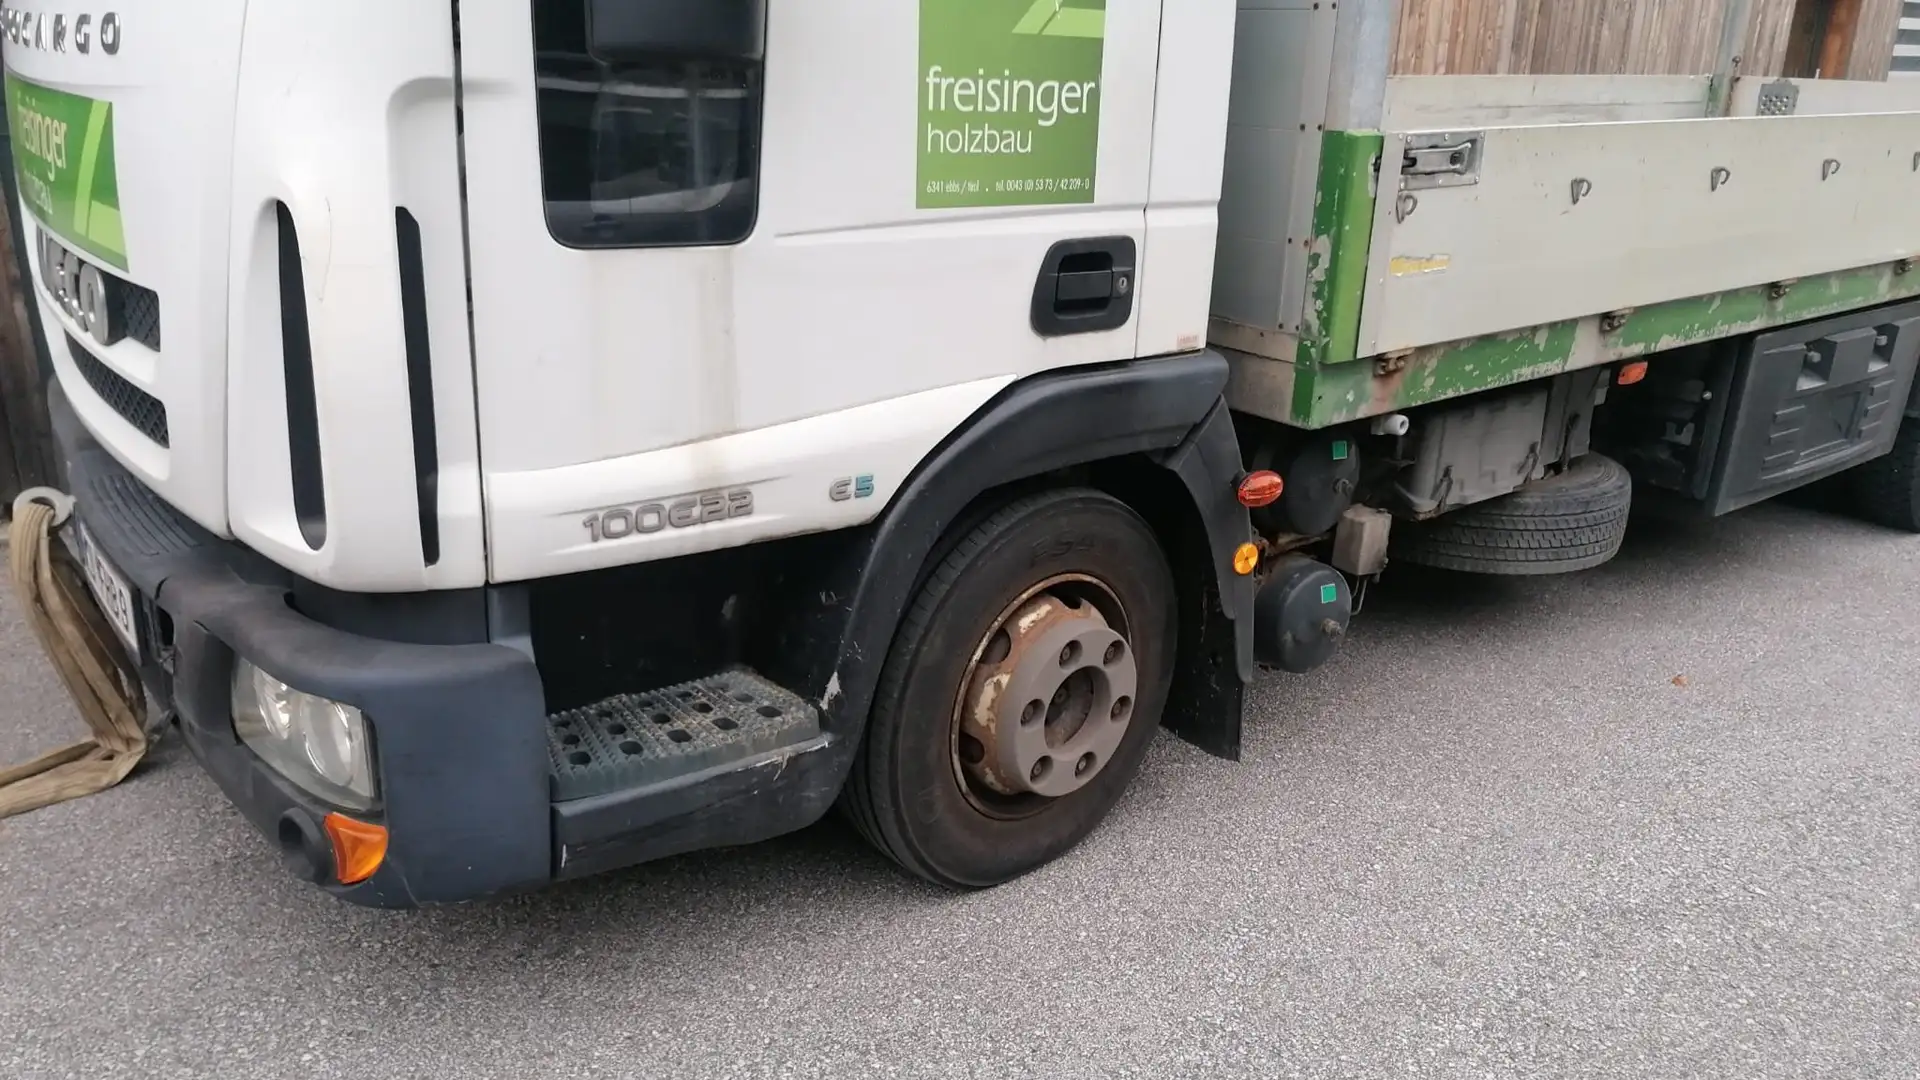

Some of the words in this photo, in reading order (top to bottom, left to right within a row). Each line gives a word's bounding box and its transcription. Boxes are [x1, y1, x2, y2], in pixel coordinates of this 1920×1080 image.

[926, 65, 1096, 127] freisinger
[927, 122, 1032, 153] holzbau
[926, 180, 943, 193] 6341
[1006, 179, 1023, 192] 0043
[829, 474, 875, 501] E5
[583, 489, 754, 542] 100E22
